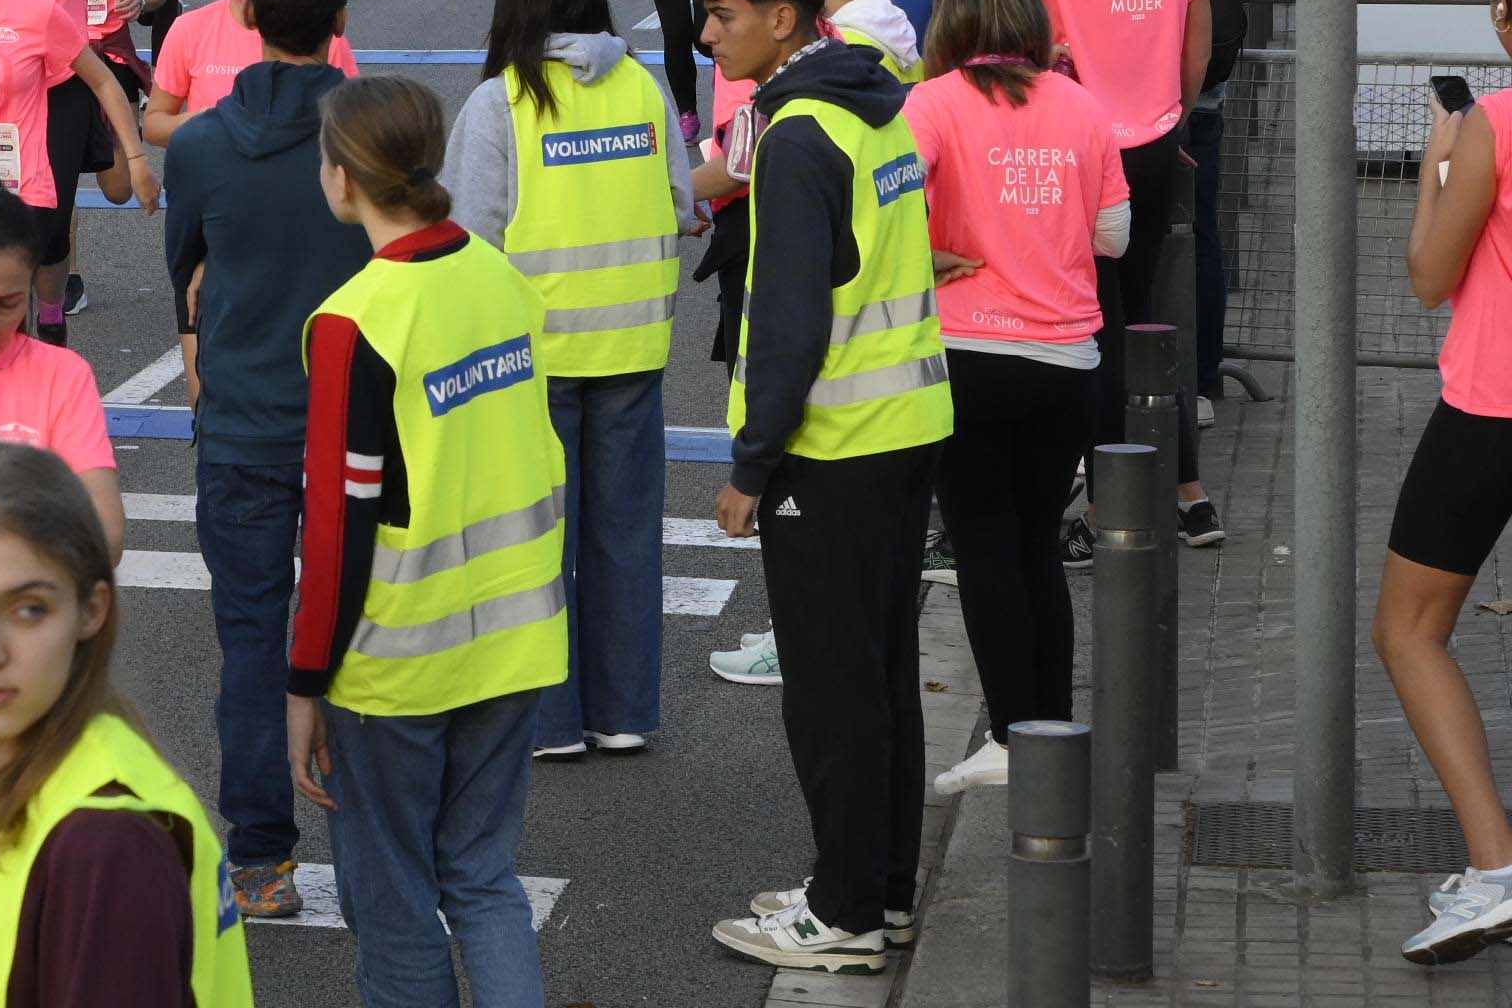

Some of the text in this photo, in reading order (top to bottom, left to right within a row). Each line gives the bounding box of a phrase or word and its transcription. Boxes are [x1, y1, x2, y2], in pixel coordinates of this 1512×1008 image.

[545, 132, 649, 158] VOLUNTARIS
[988, 147, 1078, 167] CARRERA
[1006, 167, 1060, 185] DE LA
[1000, 186, 1063, 205] MUJER
[972, 311, 1024, 330] OYSHO
[429, 346, 532, 406] VOLUNTARIS
[775, 508, 801, 516] adidas
